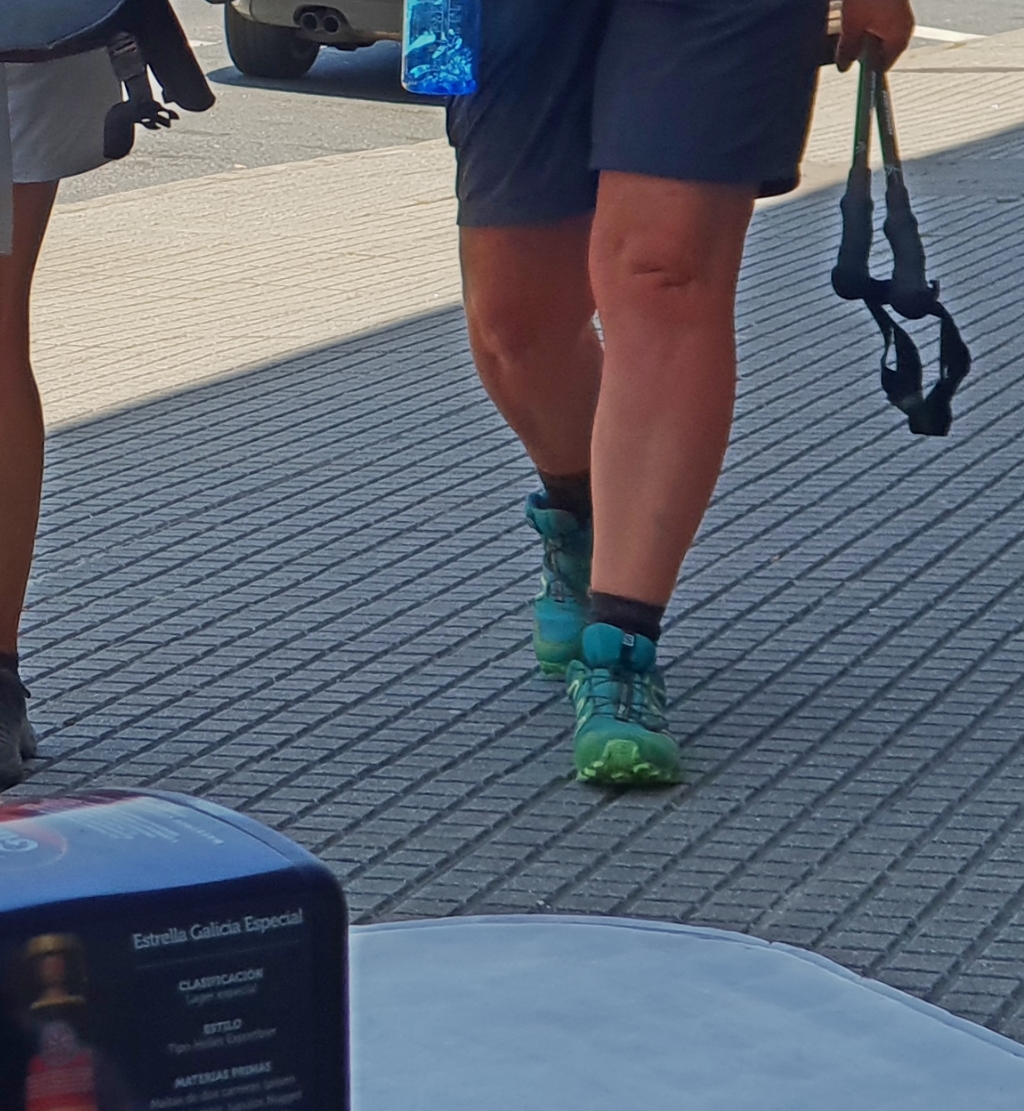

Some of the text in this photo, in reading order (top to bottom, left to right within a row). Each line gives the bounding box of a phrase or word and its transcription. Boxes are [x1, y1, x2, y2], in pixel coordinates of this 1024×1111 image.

[132, 908, 304, 950] Estrella Galicia Especial
